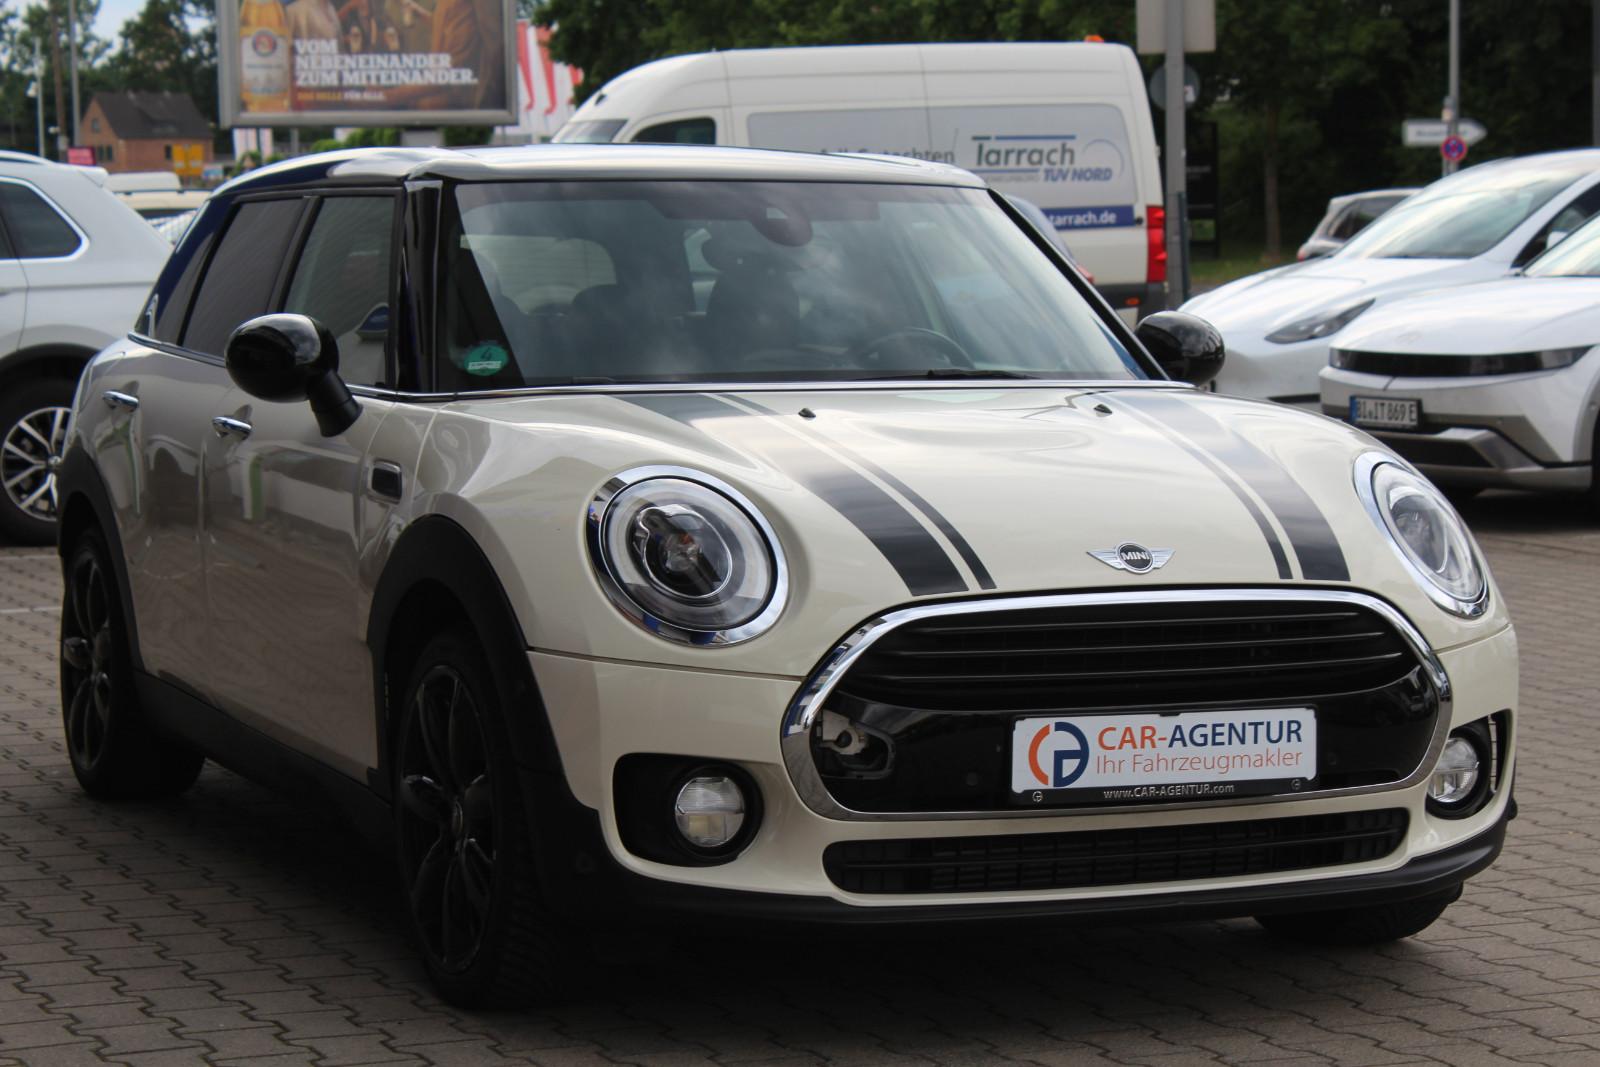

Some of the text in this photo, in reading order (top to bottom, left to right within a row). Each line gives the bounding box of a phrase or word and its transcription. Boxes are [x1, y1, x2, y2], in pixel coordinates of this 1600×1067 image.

[294, 39, 338, 54] VOM
[296, 54, 452, 70] NEBENEINANDER
[297, 69, 478, 87] ZUM MITEINANDER.
[1071, 167, 1113, 182] NORD
[1121, 551, 1151, 560] MINI
[1097, 719, 1303, 751] CAR-AGENTUR
[1096, 748, 1303, 774] Ihr Fahrzeugmakler
[1103, 784, 1235, 799] www.CAR-AGENTUR.com
